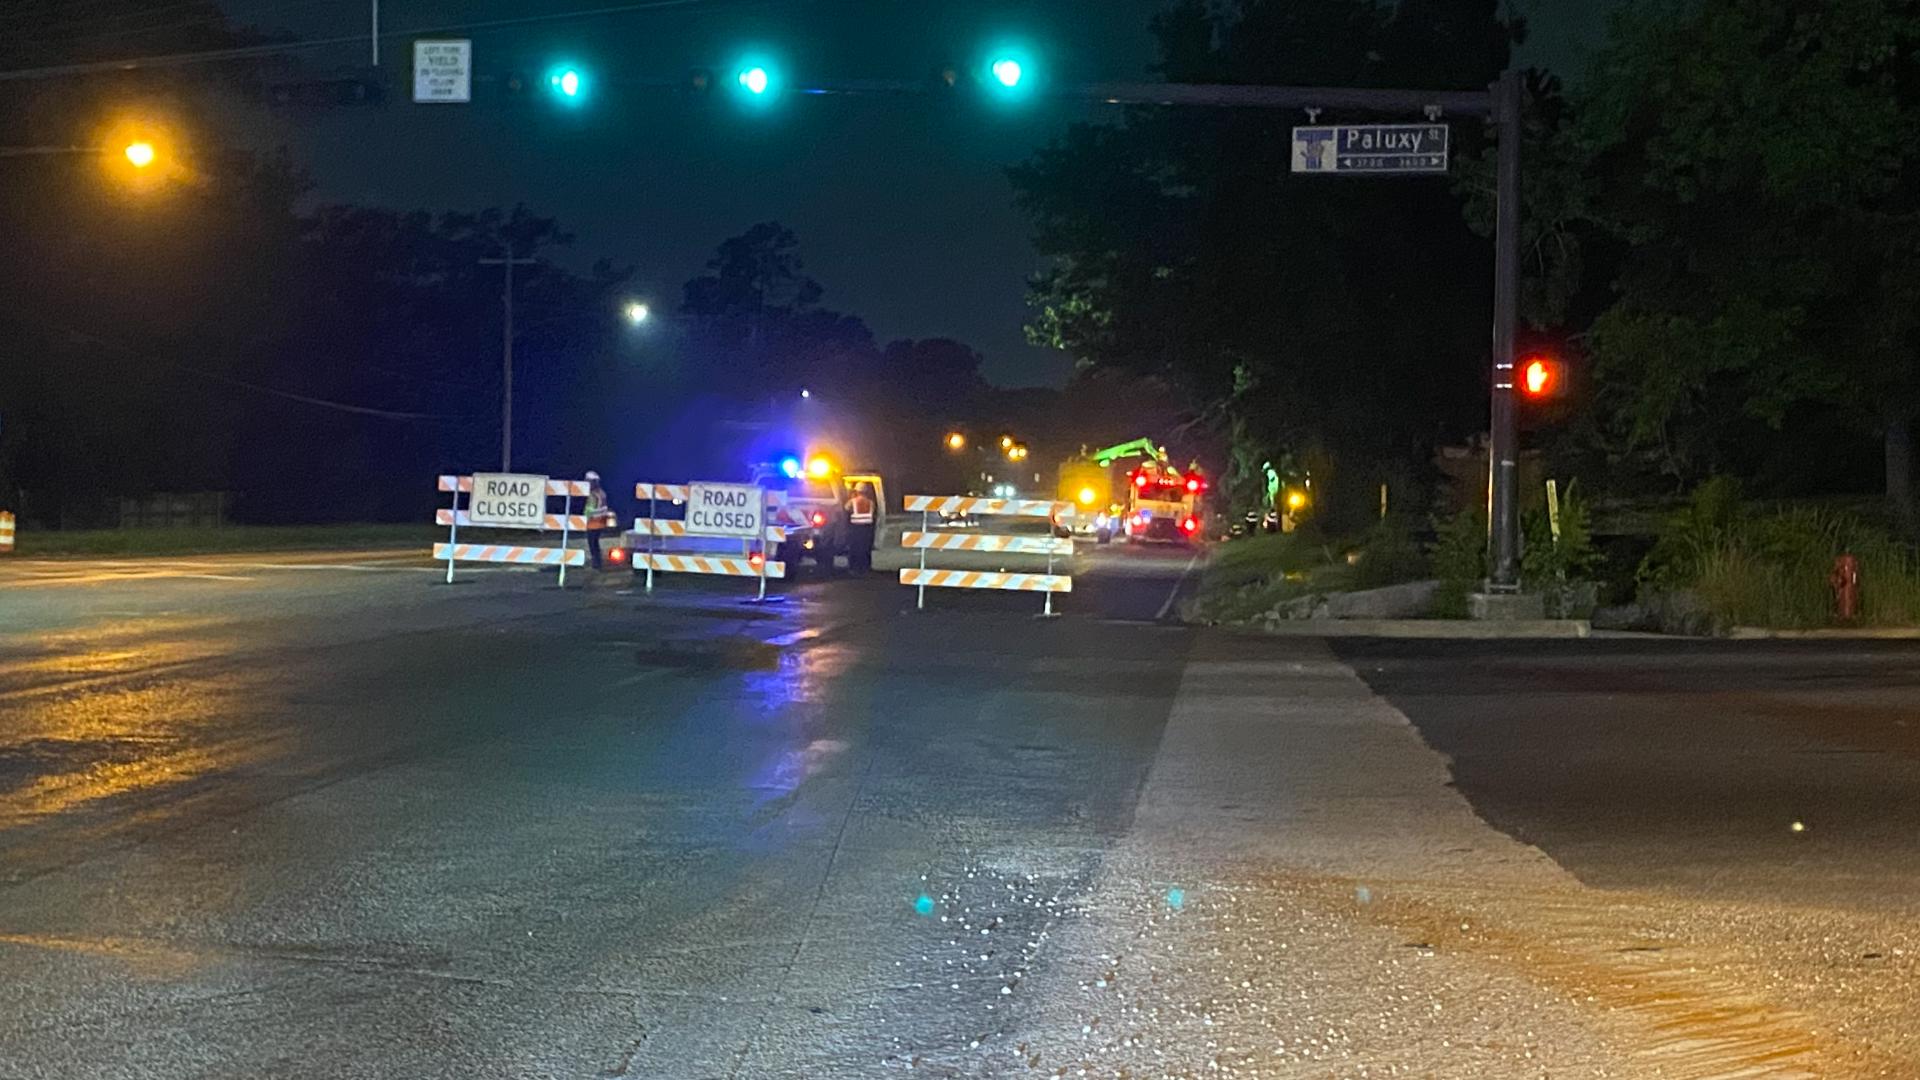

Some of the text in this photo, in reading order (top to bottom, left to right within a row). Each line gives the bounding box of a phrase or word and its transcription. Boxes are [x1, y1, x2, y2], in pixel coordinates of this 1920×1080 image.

[428, 56, 458, 66] YIELD
[1347, 130, 1423, 153] Paluxy
[487, 481, 530, 497] ROAD
[703, 490, 747, 507] ROAD
[477, 501, 538, 517] CLOSED
[693, 511, 755, 529] CLOSED
